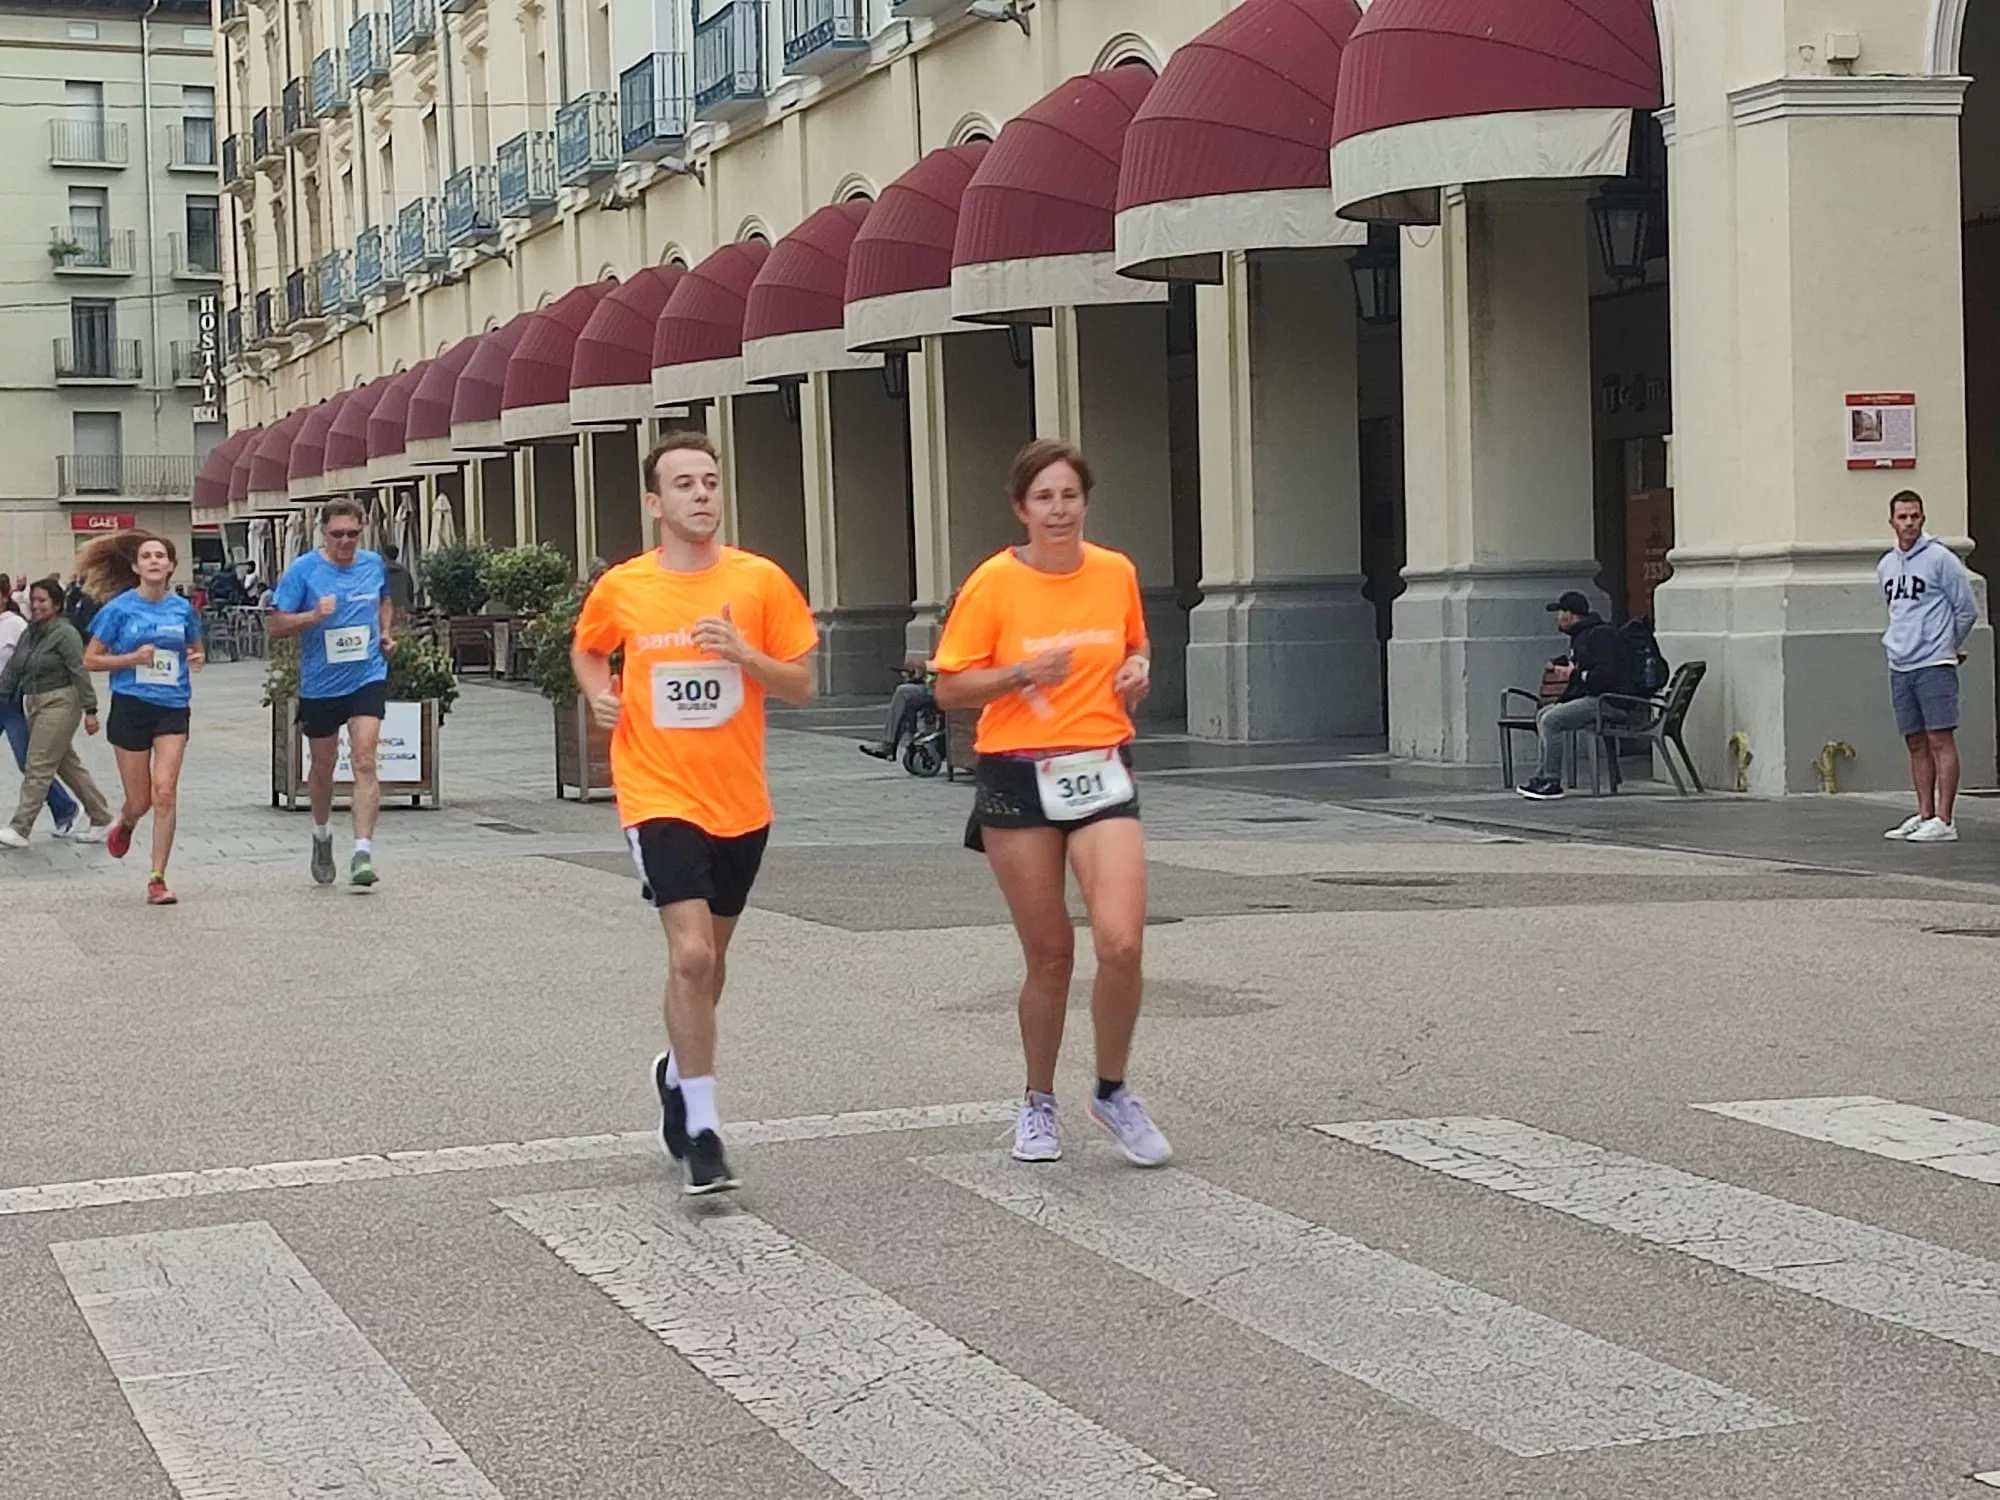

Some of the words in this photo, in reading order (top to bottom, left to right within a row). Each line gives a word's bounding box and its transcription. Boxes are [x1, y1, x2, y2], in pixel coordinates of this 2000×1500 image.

[201, 296, 217, 402] HOSTAL
[1885, 574, 1926, 605] GAP
[666, 679, 721, 701] 300
[1056, 773, 1106, 798] 301
